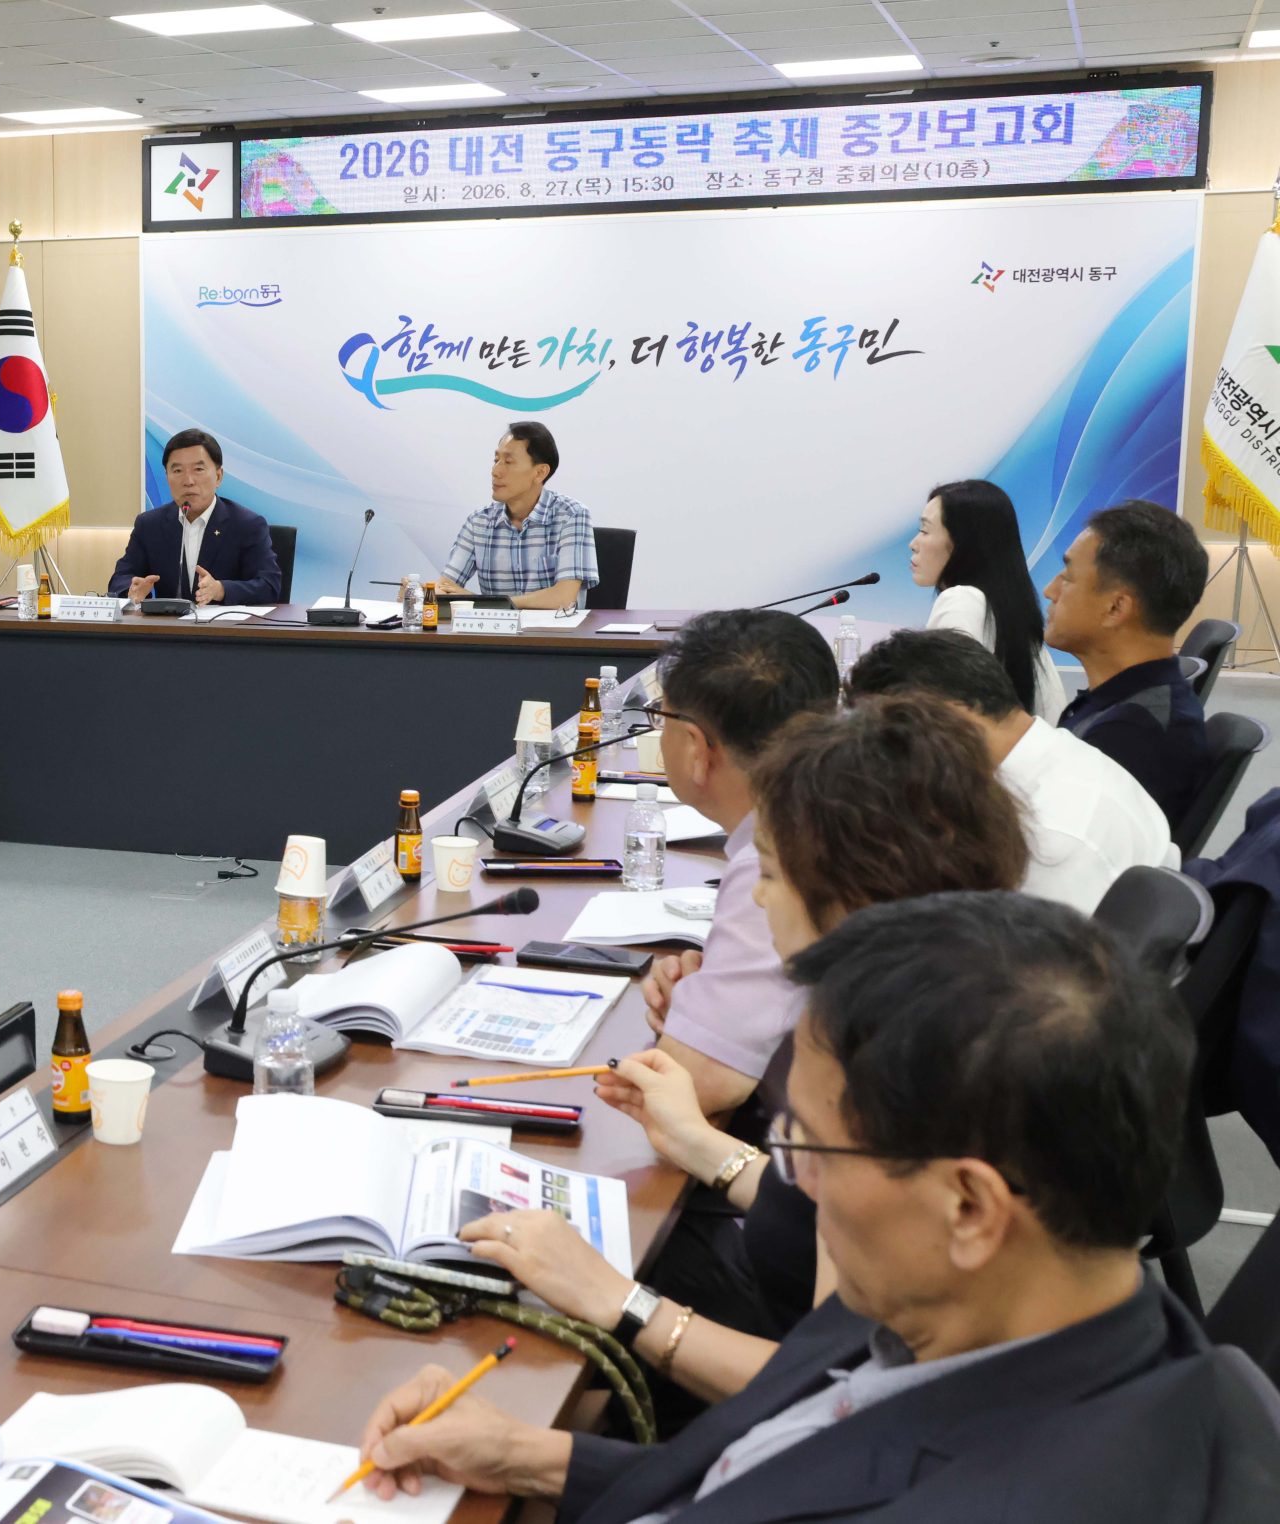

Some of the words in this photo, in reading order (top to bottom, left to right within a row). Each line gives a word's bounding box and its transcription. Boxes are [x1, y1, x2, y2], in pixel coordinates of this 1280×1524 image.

[339, 138, 430, 180] 2026
[448, 133, 524, 176] 대전
[544, 122, 715, 174] 동구동락
[732, 116, 819, 163] 축제
[839, 102, 1076, 157] 중간보고회
[402, 184, 447, 204] 일시:
[461, 184, 511, 201] 2026.
[622, 175, 675, 194] 15:30
[705, 171, 753, 191] 장소:
[762, 167, 825, 189] 동구청
[834, 159, 991, 184] 중회의실(10층)
[1012, 266, 1084, 284] 대전광역시
[1088, 265, 1118, 282] 동구
[381, 315, 474, 373] 함께
[478, 335, 532, 370] 만든
[536, 326, 617, 371] 가치,
[631, 334, 669, 368] 더
[675, 320, 786, 384] 행복한
[791, 315, 926, 382] 동구민
